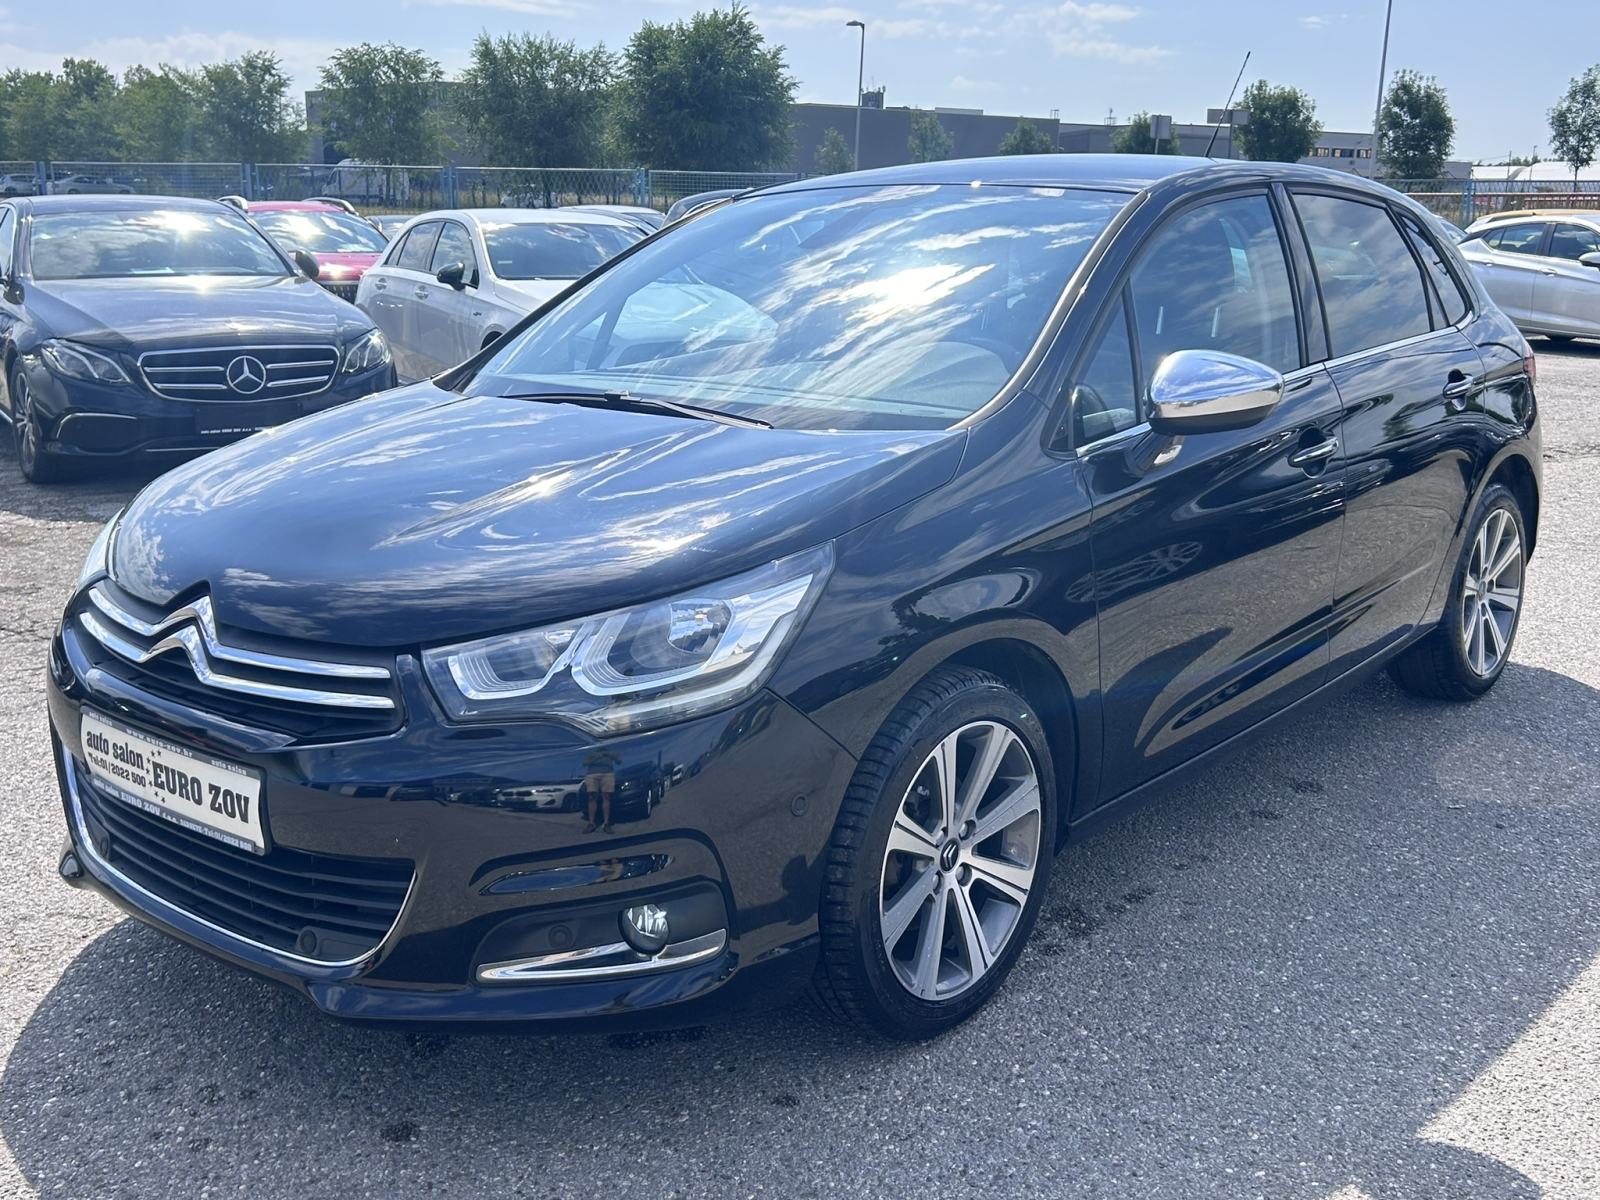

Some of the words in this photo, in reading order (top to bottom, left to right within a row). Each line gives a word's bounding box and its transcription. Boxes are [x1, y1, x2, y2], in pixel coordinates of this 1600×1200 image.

[86, 730, 110, 756] auto
[112, 741, 145, 771] salon
[131, 771, 147, 788] 500
[151, 760, 203, 806] EURO
[207, 782, 250, 824] ZOV
[120, 791, 143, 809] EURO
[143, 801, 161, 817] ZOV
